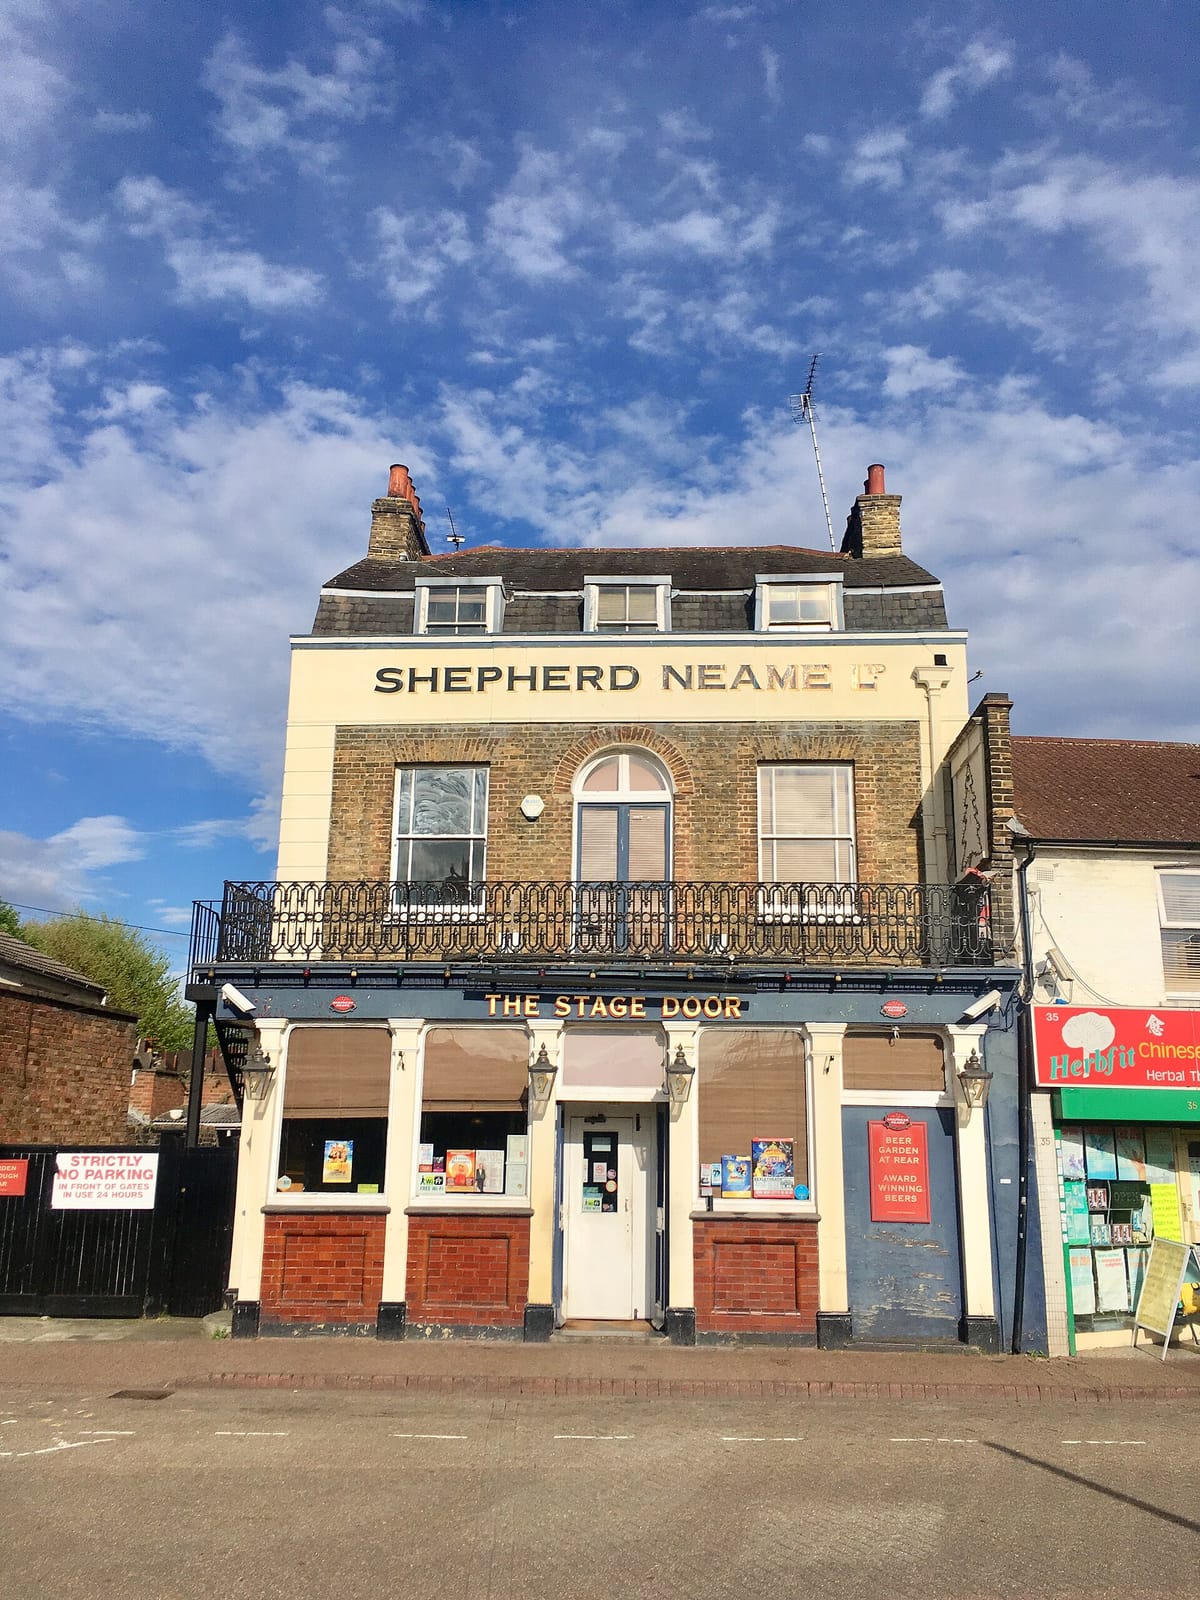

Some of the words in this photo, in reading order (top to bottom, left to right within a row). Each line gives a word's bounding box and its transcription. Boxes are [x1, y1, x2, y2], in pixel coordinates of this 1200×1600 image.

[374, 665, 640, 694] SHEPHERD
[661, 664, 832, 690] NEAME
[485, 994, 540, 1017] THE
[553, 995, 647, 1018] STAGE
[661, 995, 742, 1019] DOOR
[1046, 1013, 1059, 1021] 35
[1138, 1041, 1200, 1059] Chinese
[1050, 1045, 1135, 1080] Herbfit
[1146, 1069, 1186, 1082] Herbal
[1040, 1137, 1051, 1146] 35
[878, 1146, 919, 1154] GARDEN
[70, 1155, 143, 1167] STRICTLY
[894, 1156, 919, 1164] REAR
[57, 1169, 79, 1180] NO
[84, 1169, 154, 1180] PARKING
[878, 1184, 923, 1193] WINNING
[62, 1191, 72, 1199] IN
[75, 1191, 94, 1199] USE
[96, 1191, 109, 1199] 24
[111, 1191, 144, 1199] HOURS
[884, 1194, 917, 1202] BEERS
